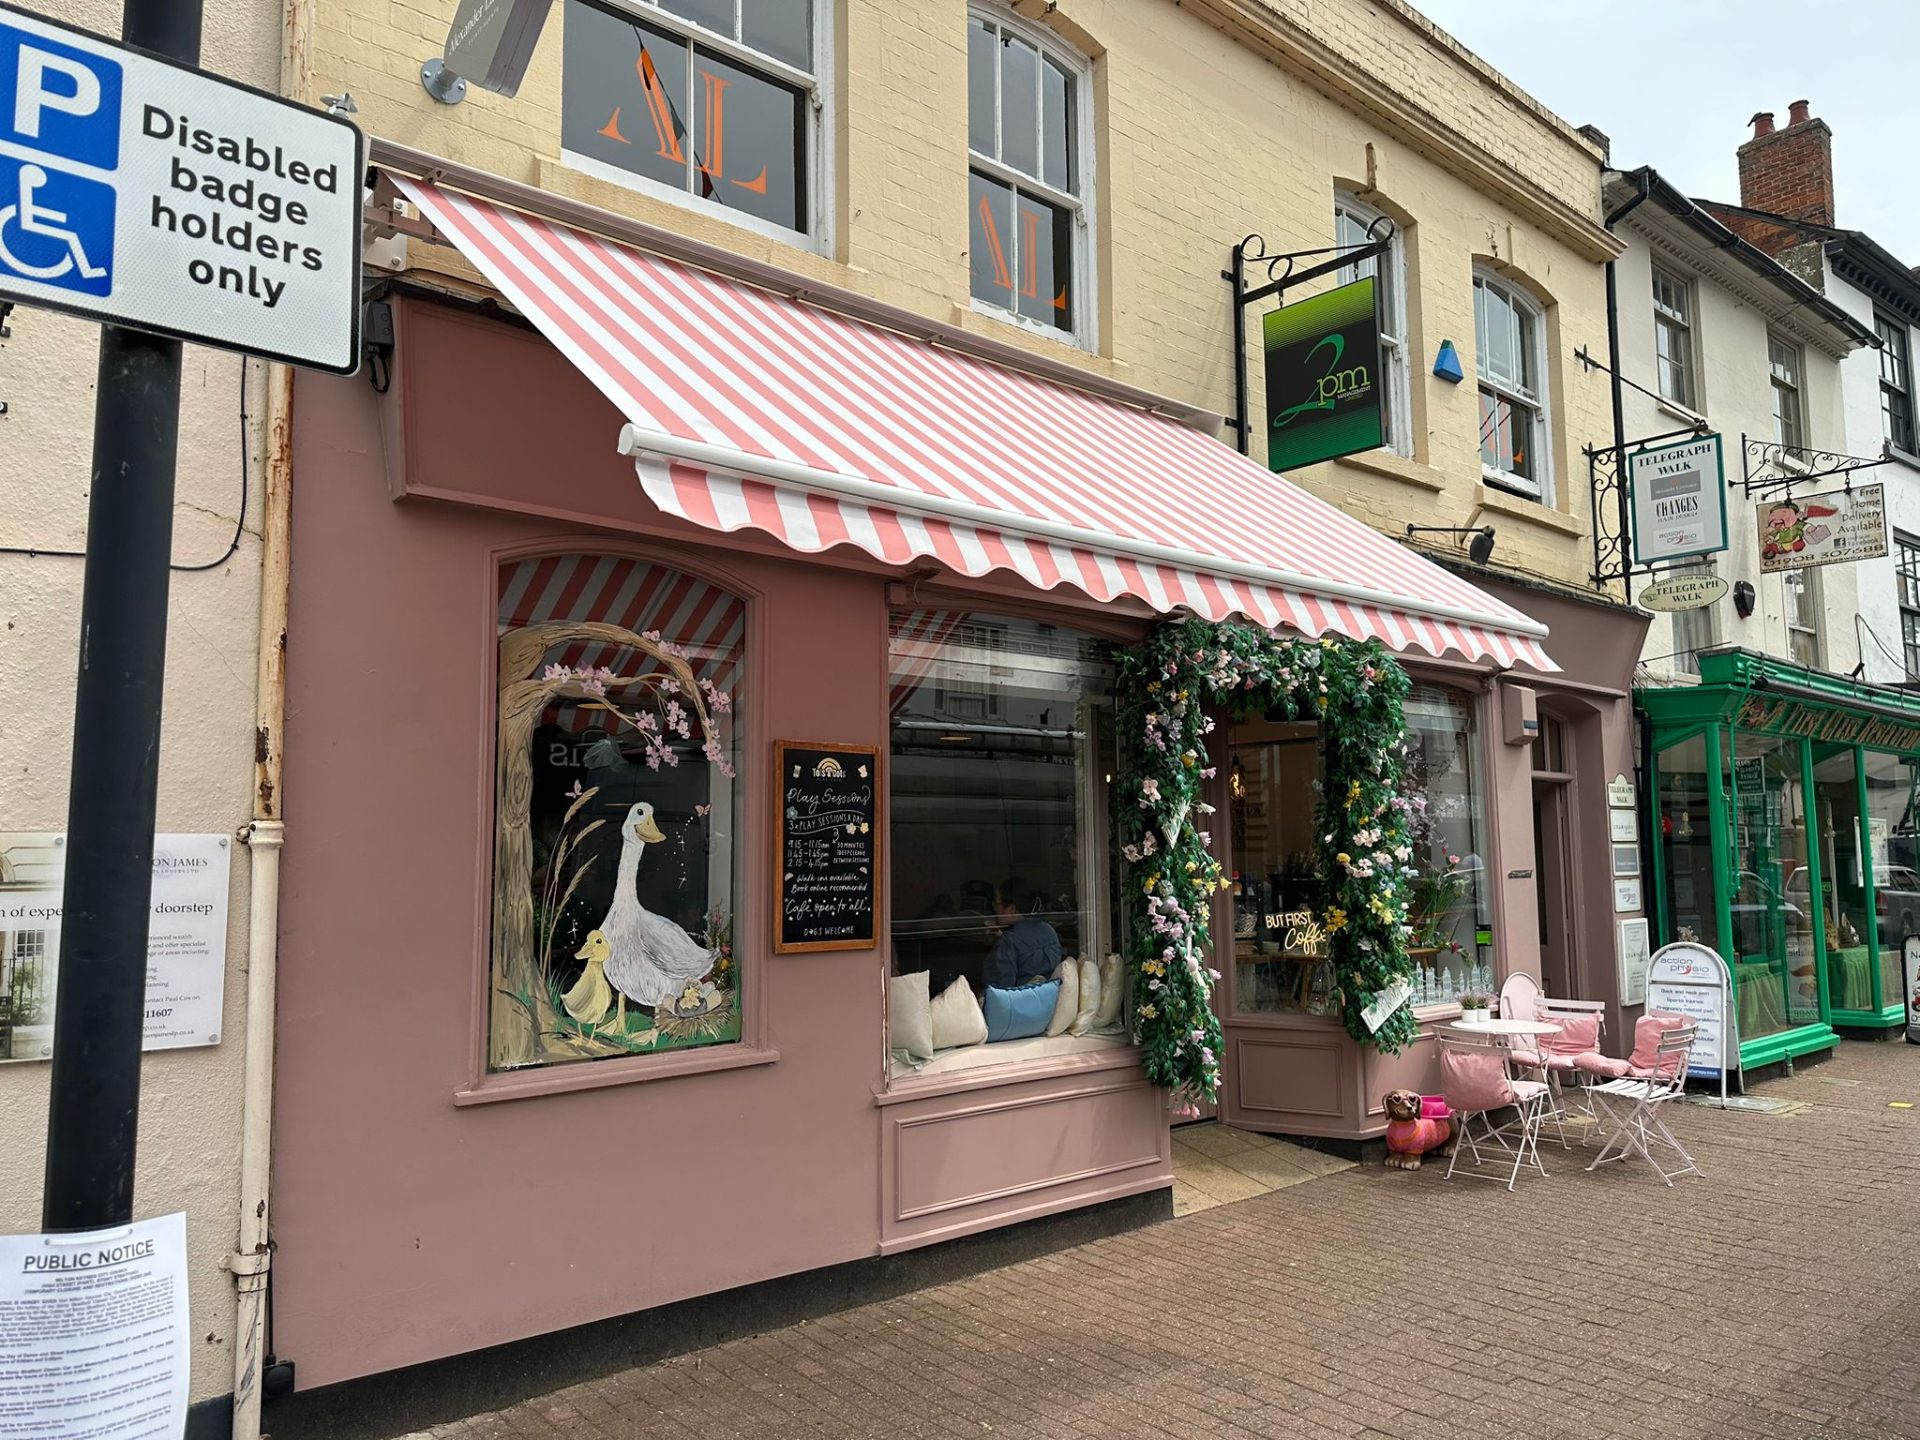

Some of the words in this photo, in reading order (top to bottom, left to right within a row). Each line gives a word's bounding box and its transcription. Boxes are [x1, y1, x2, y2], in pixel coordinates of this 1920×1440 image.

[14, 43, 101, 138] P
[142, 103, 338, 194] Disabled
[171, 157, 308, 225] badge
[151, 195, 322, 271] holders
[188, 258, 285, 308] only
[1637, 444, 1711, 467] TELEGRAPH
[1658, 461, 1691, 475] WALK
[1860, 488, 1880, 496] Free
[1656, 496, 1698, 517] CHANGES
[1851, 499, 1880, 509] Home
[1842, 510, 1882, 522] Delivery
[1837, 519, 1882, 534] Available
[1764, 554, 1814, 567] 01908
[1656, 580, 1719, 595] TELEGRAPH
[1672, 592, 1702, 602] WALK
[786, 787, 820, 814] Play
[800, 821, 815, 830] PLAY
[819, 814, 846, 827] SESSIONS
[173, 858, 208, 867] JAMES
[10, 906, 26, 918] of
[29, 907, 63, 920] expe
[155, 903, 213, 915] doorstep
[814, 902, 836, 917] open
[1265, 914, 1284, 928] BUT
[1286, 911, 1311, 927] FIRST
[1670, 964, 1709, 975] physio
[143, 1008, 172, 1018] 11607
[24, 1252, 92, 1270] PUBLIC
[98, 1239, 154, 1265] NOTICE
